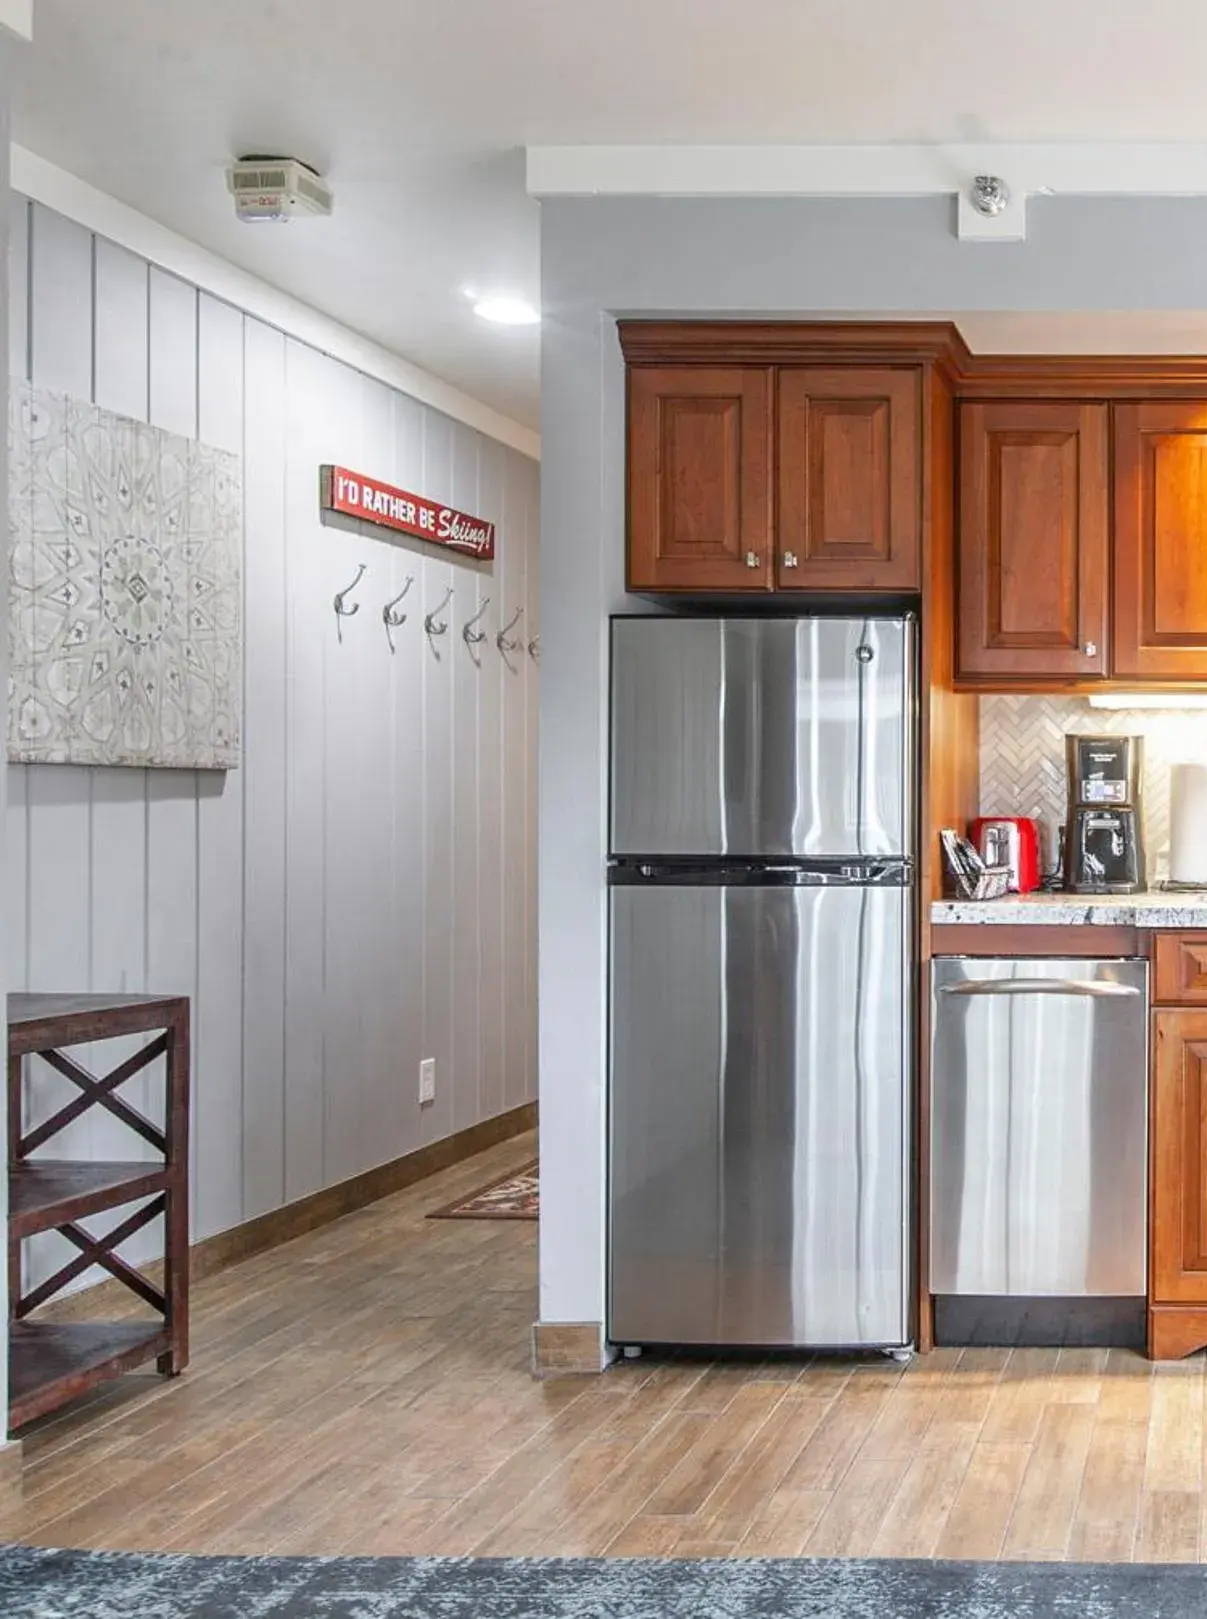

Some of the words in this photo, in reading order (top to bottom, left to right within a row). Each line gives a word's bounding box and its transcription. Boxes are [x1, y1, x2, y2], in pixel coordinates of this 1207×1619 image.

[337, 476, 358, 505] I'D
[363, 486, 417, 525] RATHER
[419, 507, 436, 532] BE
[437, 509, 491, 552] Skiing!
